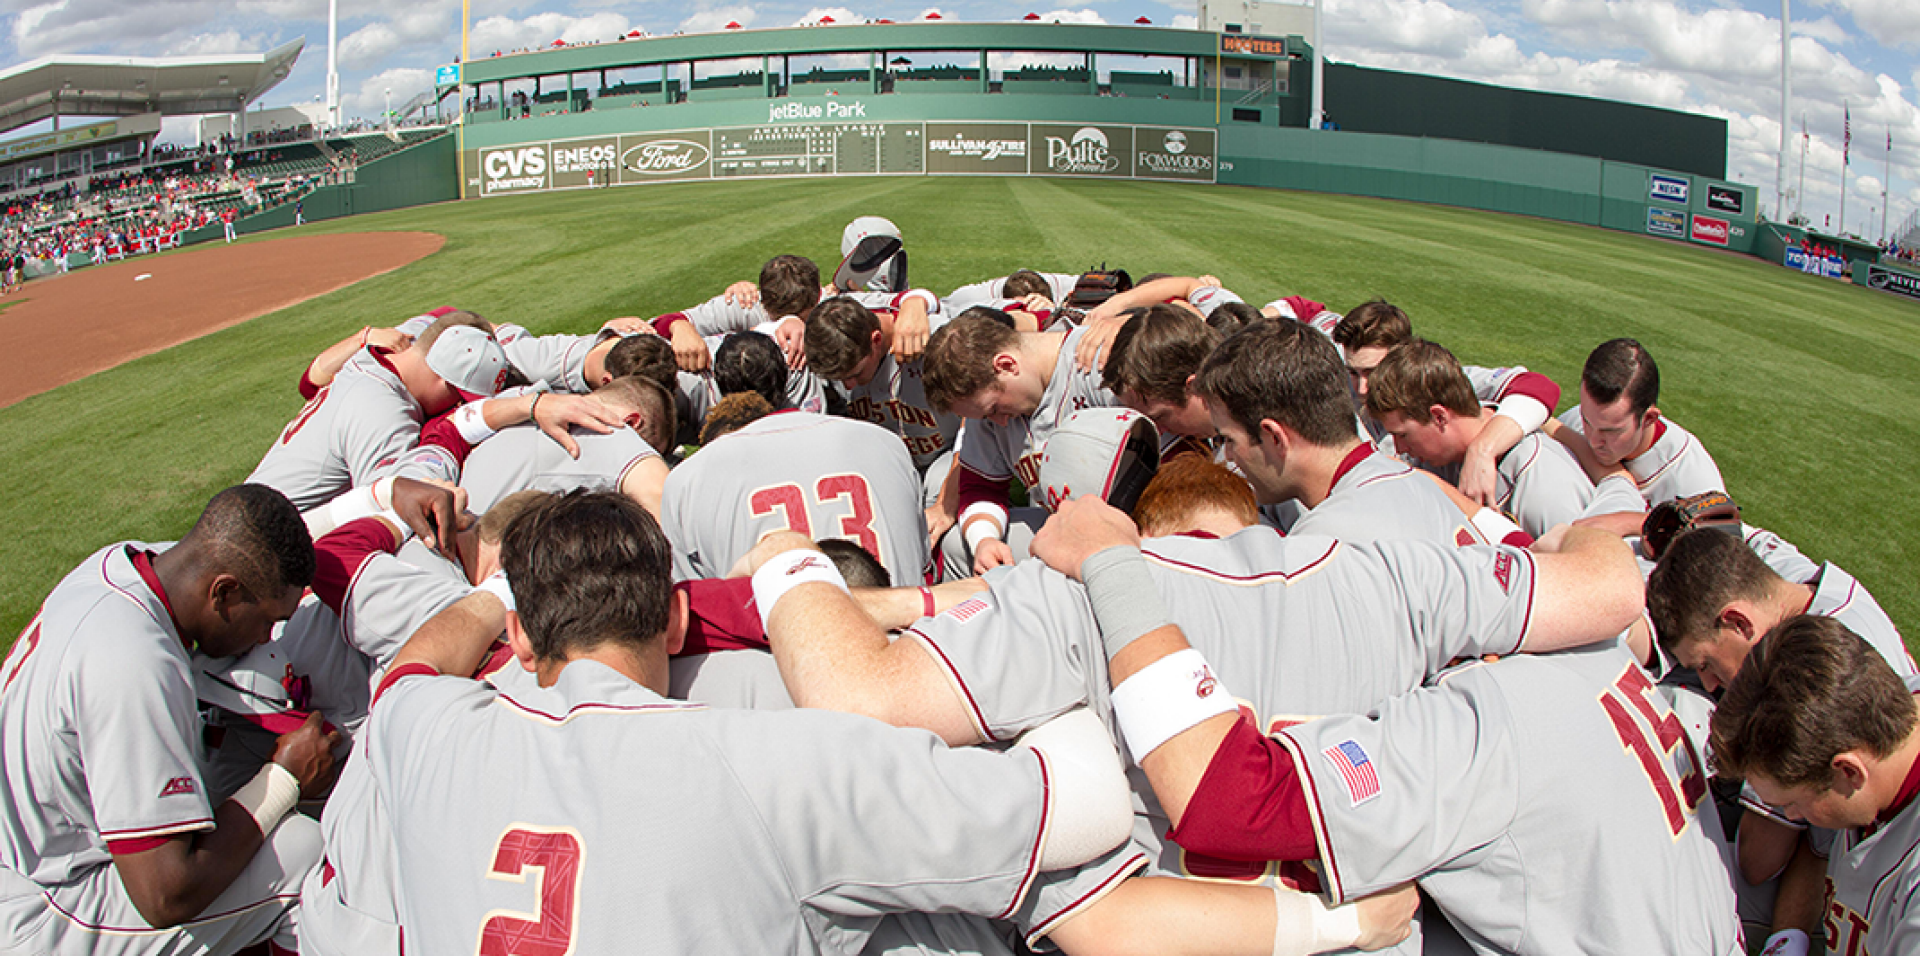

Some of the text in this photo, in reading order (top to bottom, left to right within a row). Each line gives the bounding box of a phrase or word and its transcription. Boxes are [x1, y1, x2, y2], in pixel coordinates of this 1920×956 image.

[1224, 37, 1281, 53] HOOTERS
[768, 101, 866, 122] jetBlue Park
[484, 146, 545, 179] CVS
[554, 145, 616, 165] ENEOS
[637, 144, 693, 169] Ford
[1044, 136, 1108, 168] Pulte
[1139, 151, 1211, 170] FOXWOODS
[486, 176, 545, 193] pharmacy
[1594, 657, 1709, 844] 15
[158, 776, 194, 798] ACC
[473, 821, 587, 956] 2
